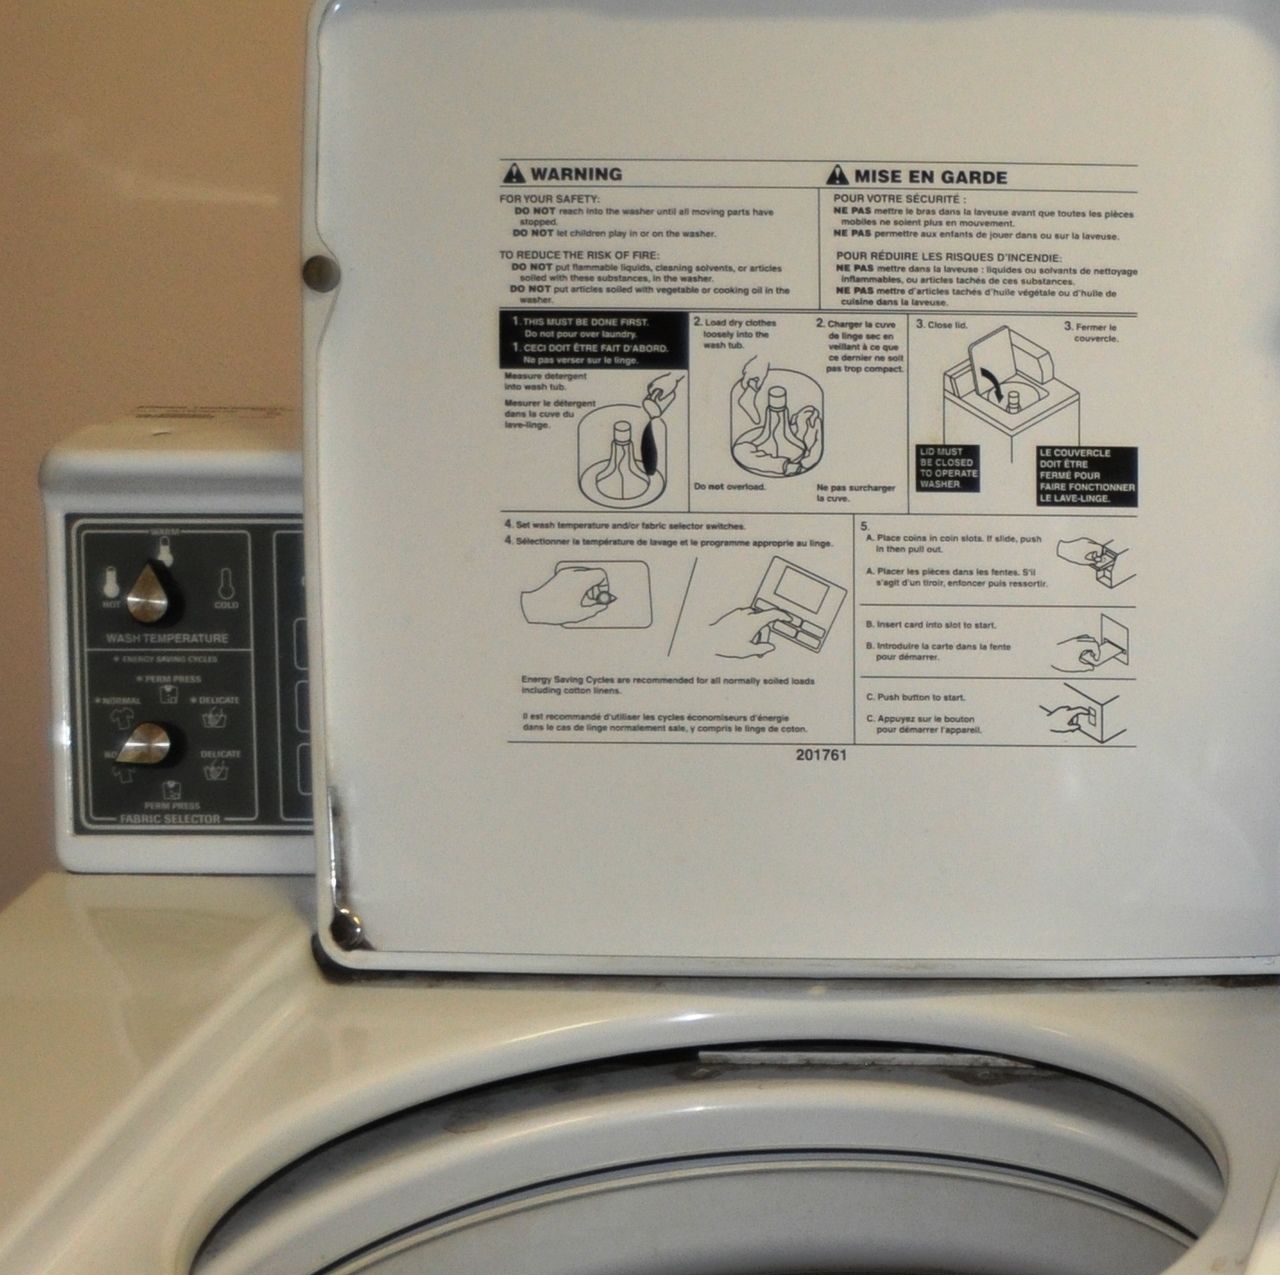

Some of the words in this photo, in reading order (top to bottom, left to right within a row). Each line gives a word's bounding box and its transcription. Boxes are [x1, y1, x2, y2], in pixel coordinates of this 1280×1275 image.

[530, 167, 623, 181] WARNING
[854, 169, 902, 184] MISE
[907, 170, 935, 184] EN
[939, 170, 1008, 184] GARDE
[499, 194, 522, 204] FOR
[522, 194, 553, 204] YOUR
[833, 194, 865, 203] POUR
[866, 194, 903, 203] VOTRE
[512, 228, 529, 237] DO
[529, 228, 554, 237] NOT
[555, 228, 568, 237] let
[568, 228, 607, 237] children
[607, 229, 627, 239] play
[628, 229, 638, 237] in
[638, 230, 650, 238] or
[664, 229, 680, 238] the
[499, 250, 514, 260] TO
[515, 250, 561, 260] REDUCE
[562, 250, 584, 260] THE
[585, 250, 612, 260] RISK
[613, 250, 629, 260] OF
[836, 250, 868, 261] POUR
[920, 251, 943, 262] LES
[944, 252, 994, 262] RISQUES
[522, 317, 545, 327] THIS
[545, 317, 573, 327] MUST
[574, 317, 589, 327] BE
[589, 317, 618, 327] DONE
[703, 318, 727, 327] Load
[727, 318, 743, 329] dry
[743, 319, 777, 327] clothes
[926, 321, 953, 330] Close
[1074, 323, 1107, 331] Fermer
[1107, 323, 1117, 332] le
[524, 329, 538, 338] Do
[538, 329, 555, 338] not
[555, 331, 578, 340] pour
[703, 330, 735, 341] loosely
[735, 330, 754, 339] into
[753, 330, 770, 339] the
[522, 343, 547, 352] CECI
[547, 343, 571, 352] DOIT
[599, 343, 621, 352] FAIT
[703, 341, 727, 349] wash
[504, 372, 543, 380] Measure
[543, 372, 588, 383] detergent
[504, 382, 522, 391] into
[522, 382, 548, 391] wash
[920, 447, 935, 456] LID
[935, 447, 963, 456] MUST
[1039, 448, 1052, 457] LE
[1052, 449, 1111, 458] COUVERCLE
[920, 458, 933, 467] BE
[934, 458, 974, 467] CLOSED
[1039, 460, 1062, 469] DOIT
[920, 469, 933, 478] TO
[933, 469, 979, 478] OPERATE
[1072, 471, 1101, 480] POUR
[694, 482, 707, 491] Do
[706, 482, 725, 491] not
[1039, 483, 1067, 492] FAIRE
[1067, 483, 1136, 492] FONCTIONNER
[1039, 494, 1052, 503] LE
[875, 544, 885, 553] in
[885, 544, 906, 553] then
[906, 544, 925, 555] pull
[214, 601, 239, 609] COLD
[875, 620, 903, 629] Insert
[903, 620, 924, 629] card
[924, 620, 943, 629] into
[943, 620, 962, 629] slot
[962, 620, 973, 629] to
[106, 633, 141, 644] WASH
[143, 633, 229, 644] TEMPERATURE
[521, 686, 562, 697] including
[562, 686, 592, 695] cotton
[199, 696, 240, 704] DELICATE
[876, 692, 900, 701] Push
[900, 692, 931, 701] button
[931, 692, 942, 701] to
[200, 750, 240, 759] DELICATE
[795, 749, 848, 761] 201761
[120, 814, 162, 824] FABRIC
[164, 814, 221, 824] SELECTOR
